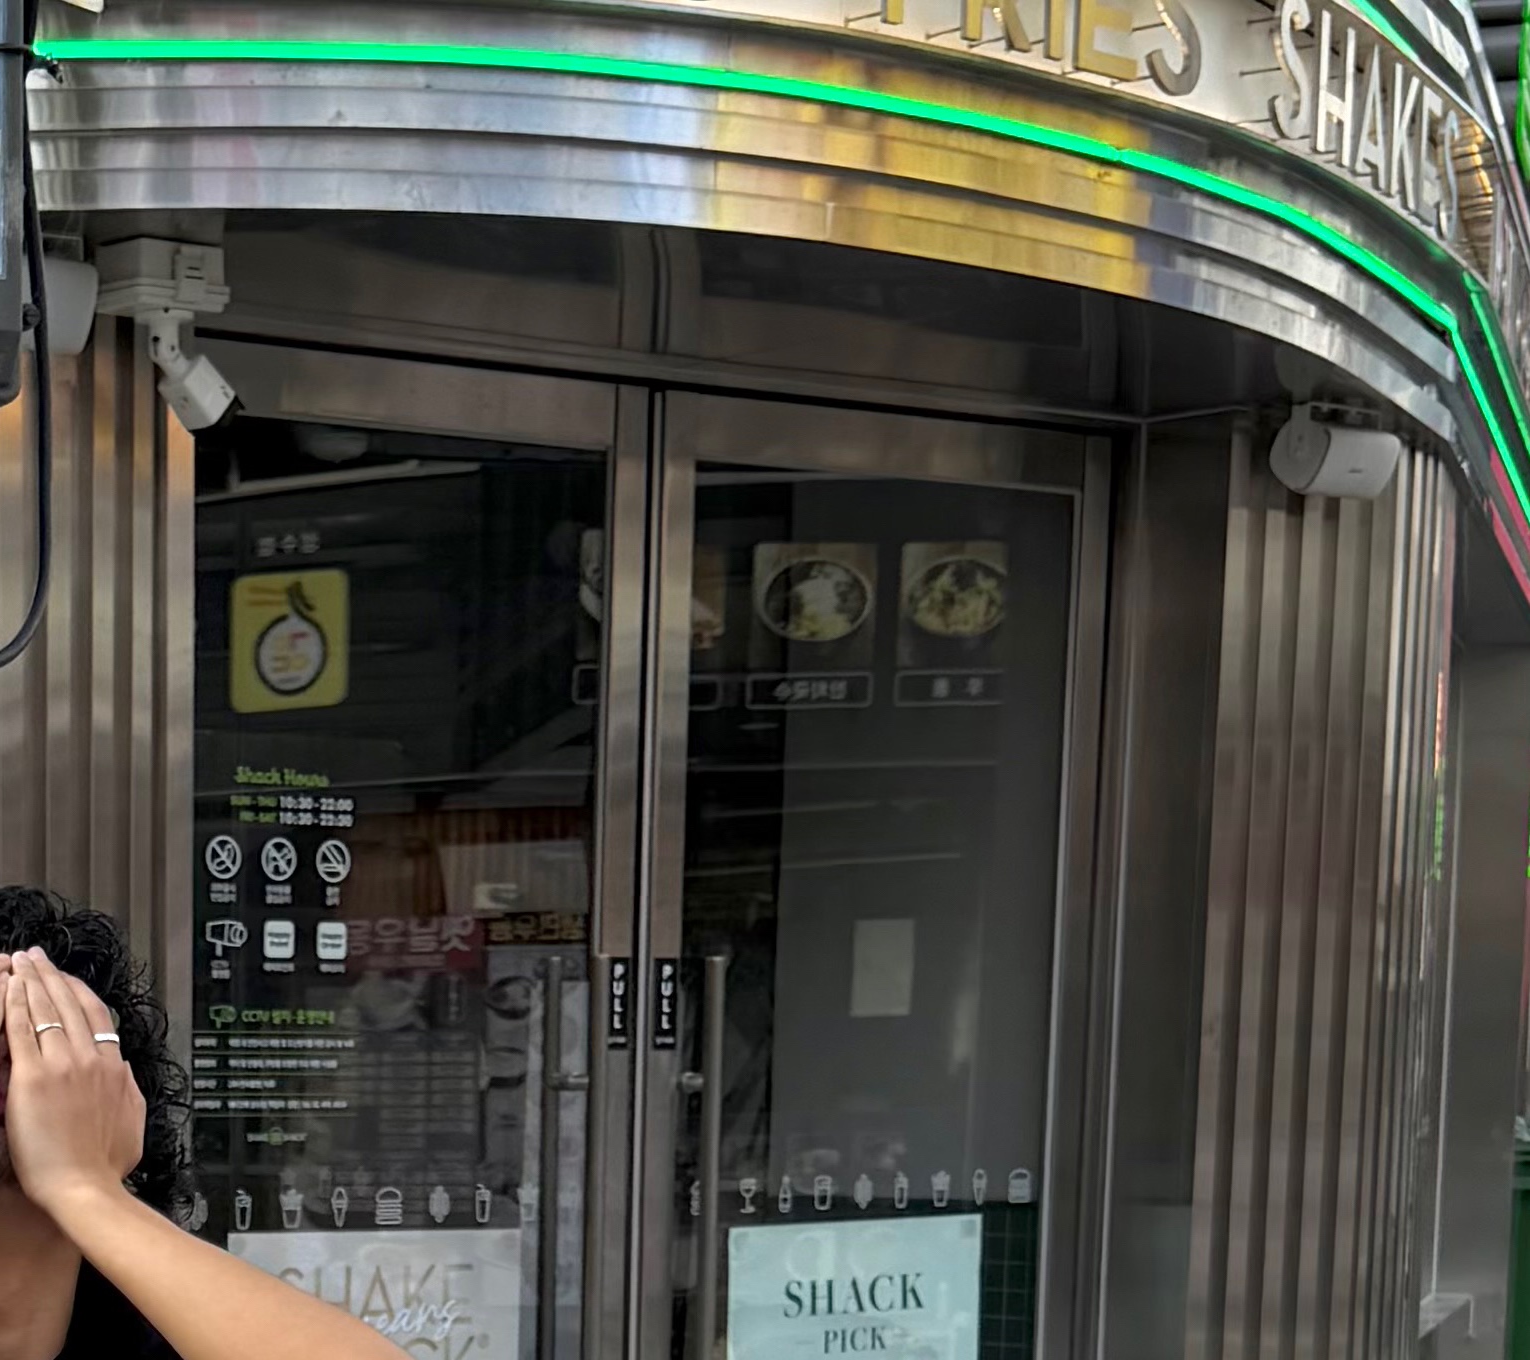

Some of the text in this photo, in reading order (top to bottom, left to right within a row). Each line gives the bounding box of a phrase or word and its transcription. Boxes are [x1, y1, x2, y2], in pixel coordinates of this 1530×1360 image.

[1269, 0, 1460, 243] SHAKES
[612, 963, 625, 1029] PULL
[661, 963, 673, 1030] PULL
[783, 1272, 924, 1319] SHACK
[823, 1326, 887, 1355] PICK
